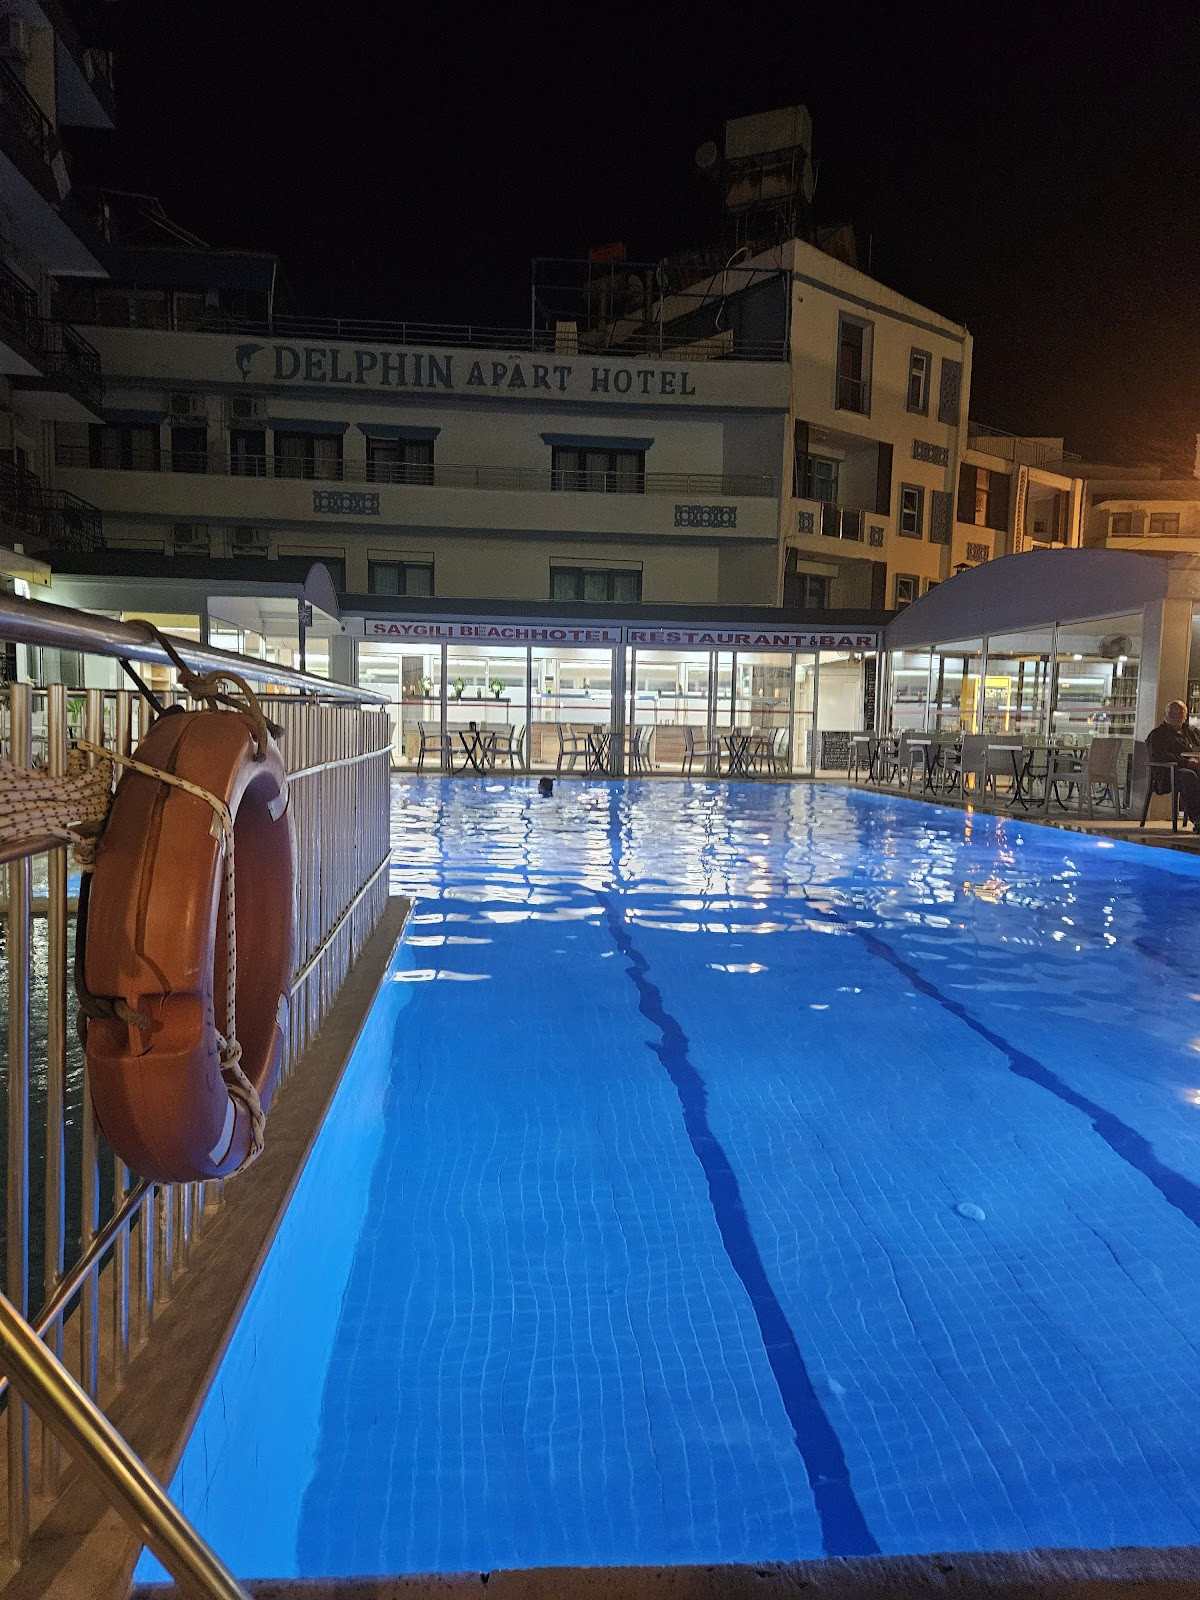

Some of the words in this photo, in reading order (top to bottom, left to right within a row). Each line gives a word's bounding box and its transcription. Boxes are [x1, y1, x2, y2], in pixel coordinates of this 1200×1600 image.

[272, 345, 454, 389] DELPHIN
[465, 361, 572, 391] APART
[590, 367, 697, 396] HOTEL
[373, 623, 453, 637] SAYGILI
